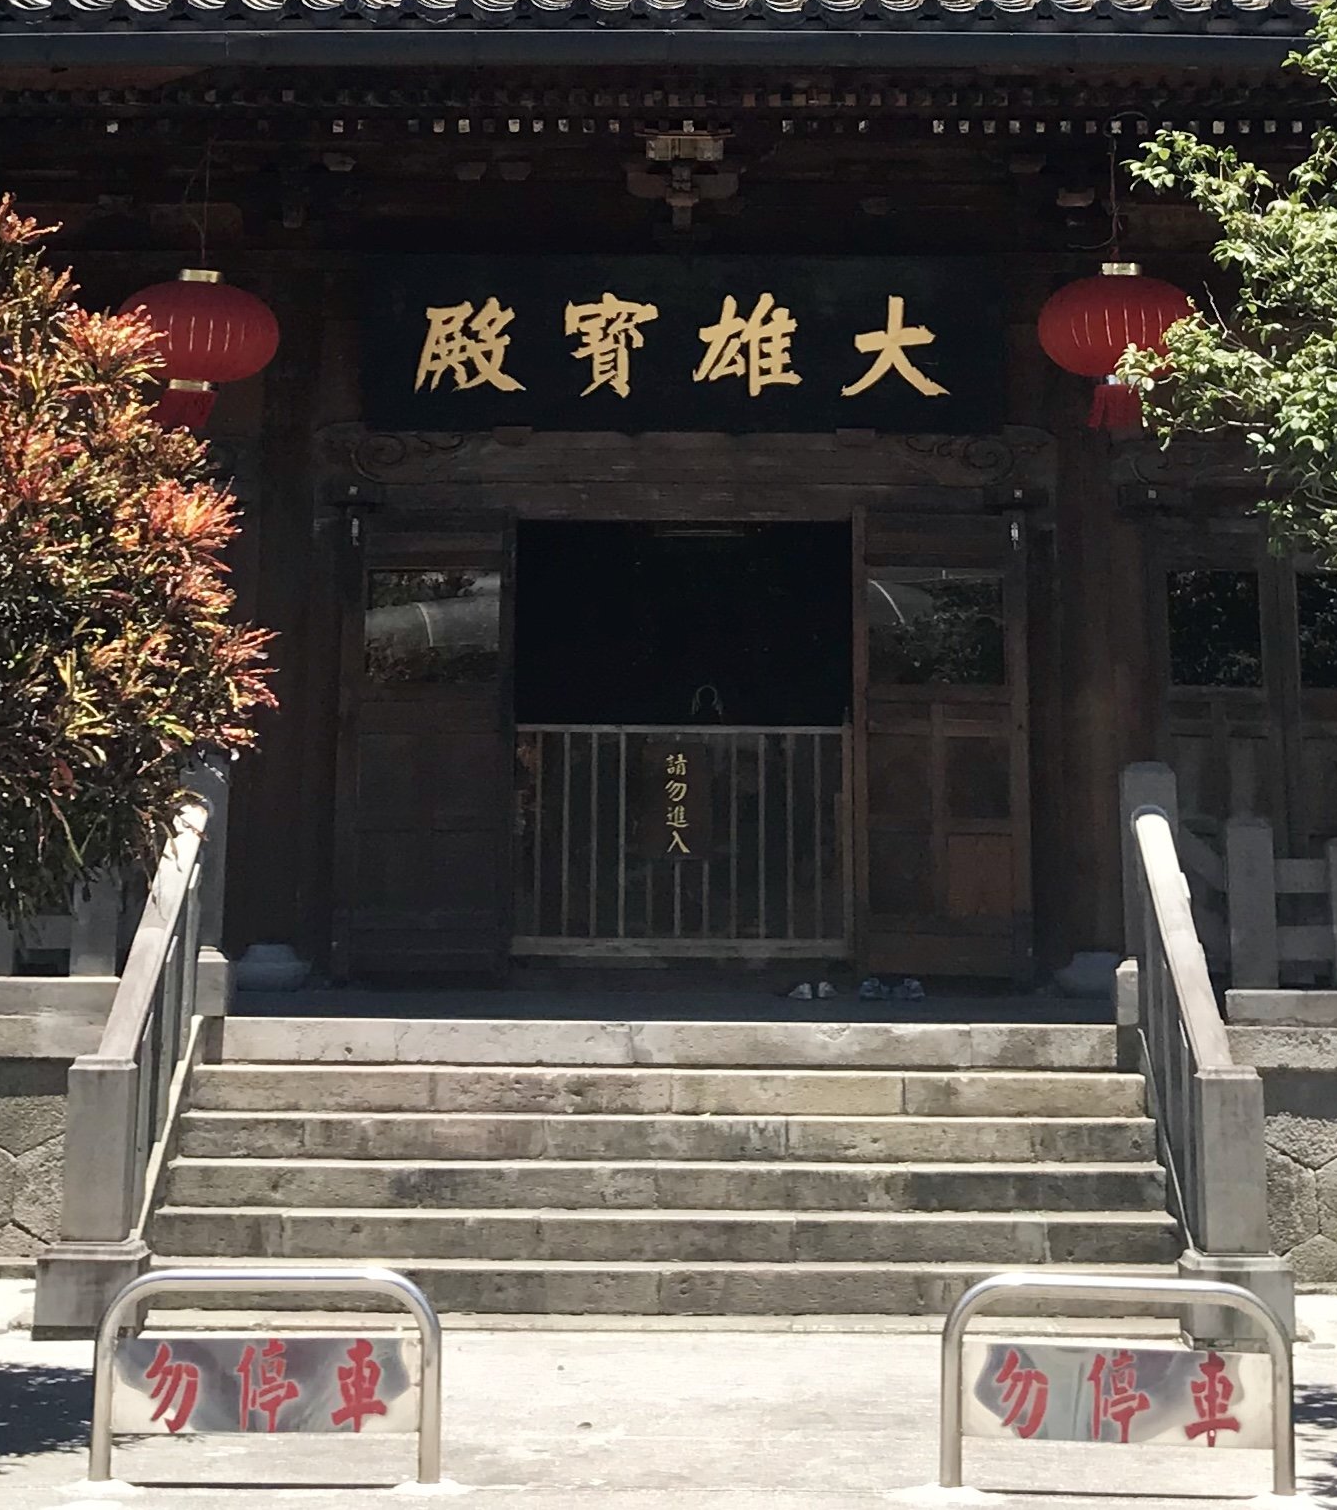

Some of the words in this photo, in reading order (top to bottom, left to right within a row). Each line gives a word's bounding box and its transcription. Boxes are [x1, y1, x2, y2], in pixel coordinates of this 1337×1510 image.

[414, 292, 951, 398] 大雄寶殿
[665, 753, 690, 854] 請勿進入
[145, 1338, 388, 1433] 勿停車
[995, 1348, 1241, 1448] 勿停車
